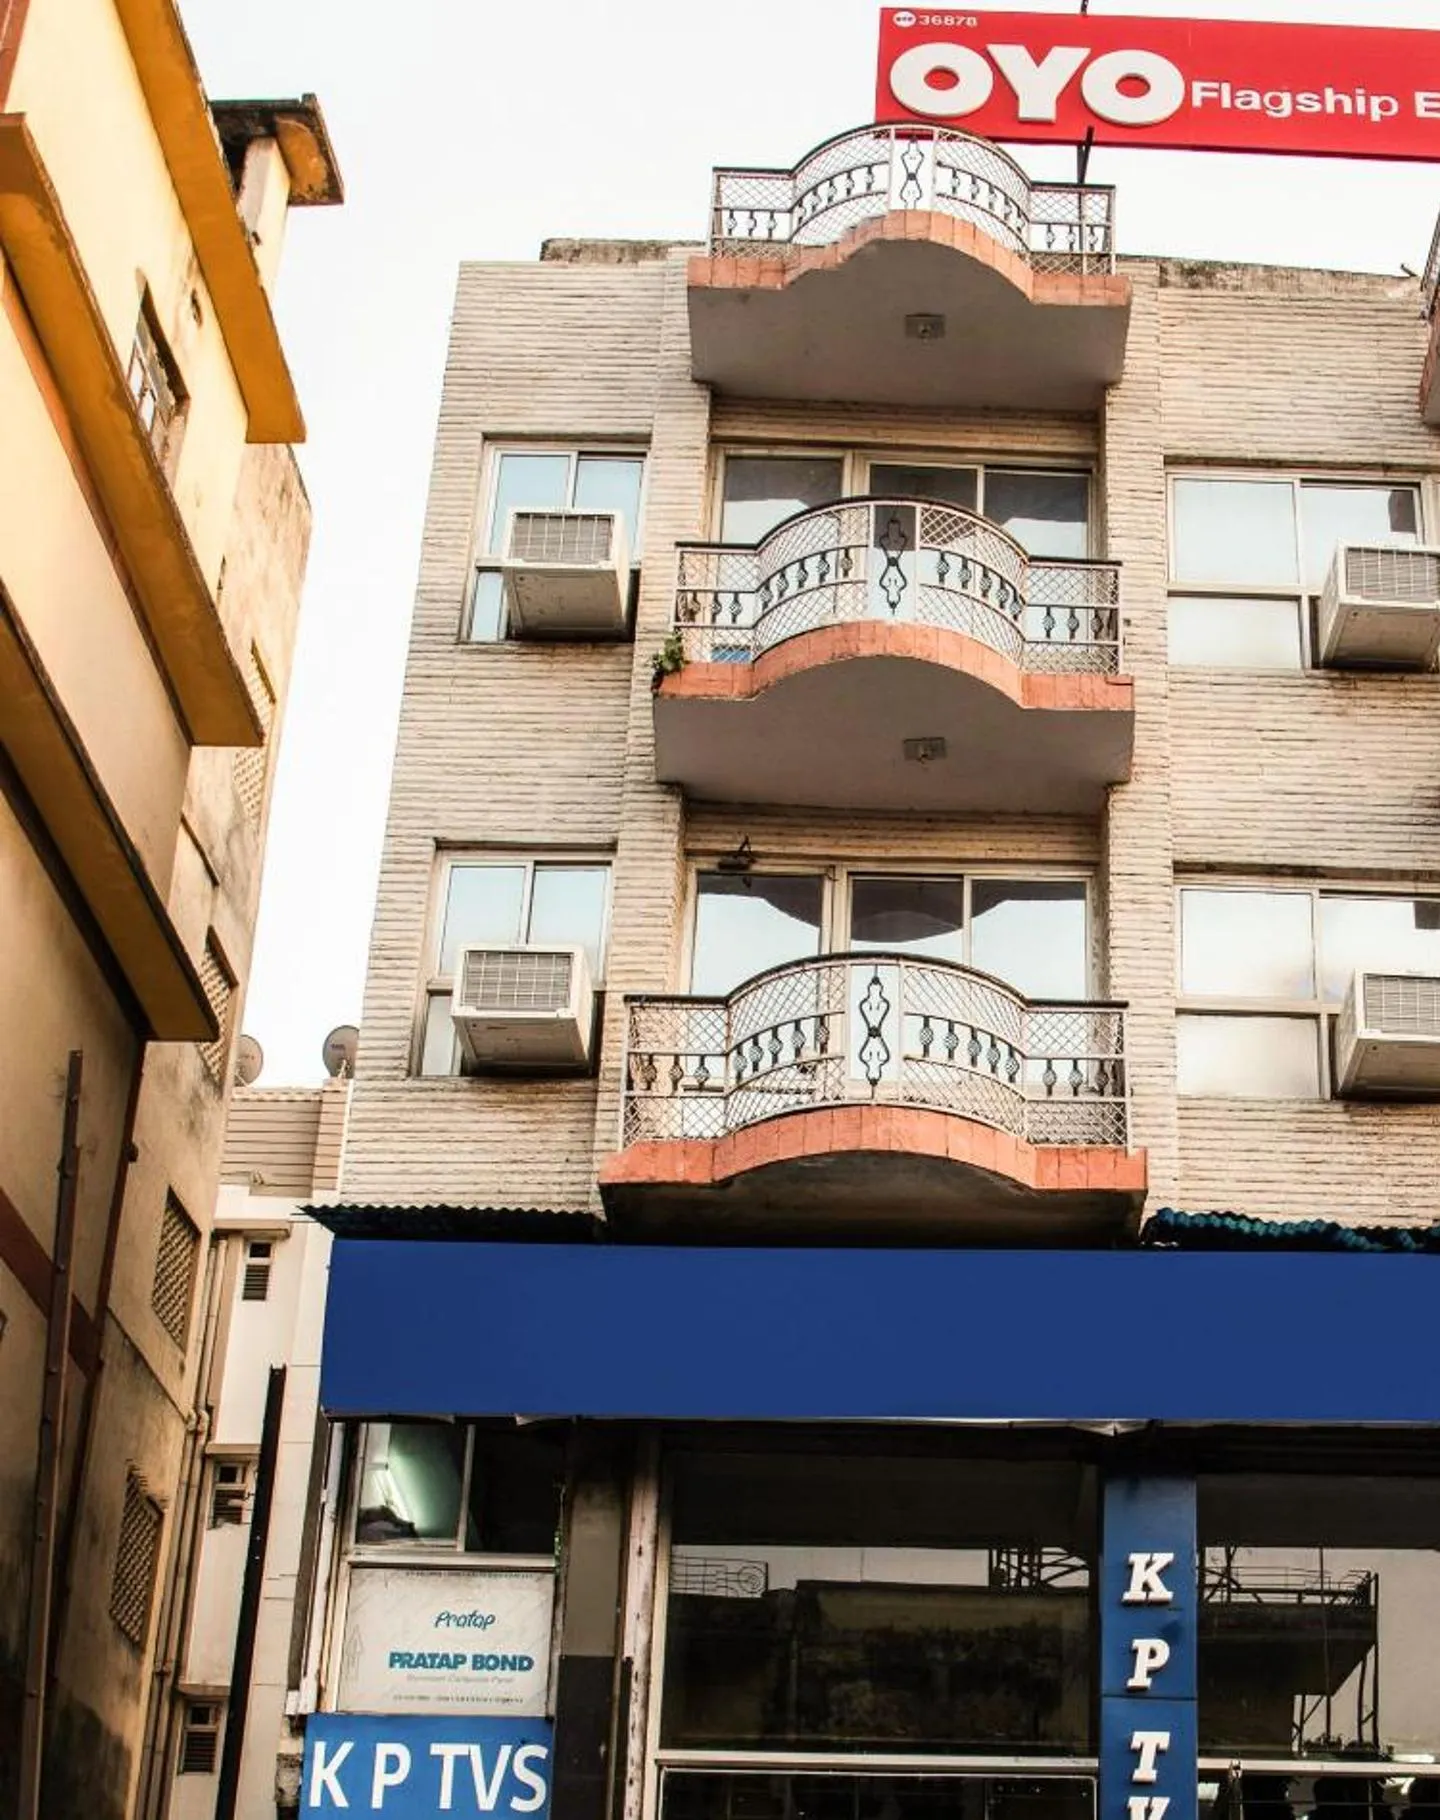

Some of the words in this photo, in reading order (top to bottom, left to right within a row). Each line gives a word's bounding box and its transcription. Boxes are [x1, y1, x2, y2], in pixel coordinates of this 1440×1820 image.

[889, 42, 1185, 126] OYO
[1191, 81, 1400, 120] Flagship
[1122, 1552, 1175, 1603] K
[435, 1610, 496, 1631] Pratap
[388, 1651, 468, 1670] PRATAP
[471, 1653, 535, 1672] BOND
[1126, 1638, 1171, 1691] P
[309, 1740, 355, 1808] K
[371, 1742, 412, 1809] P
[430, 1743, 549, 1812] TVS
